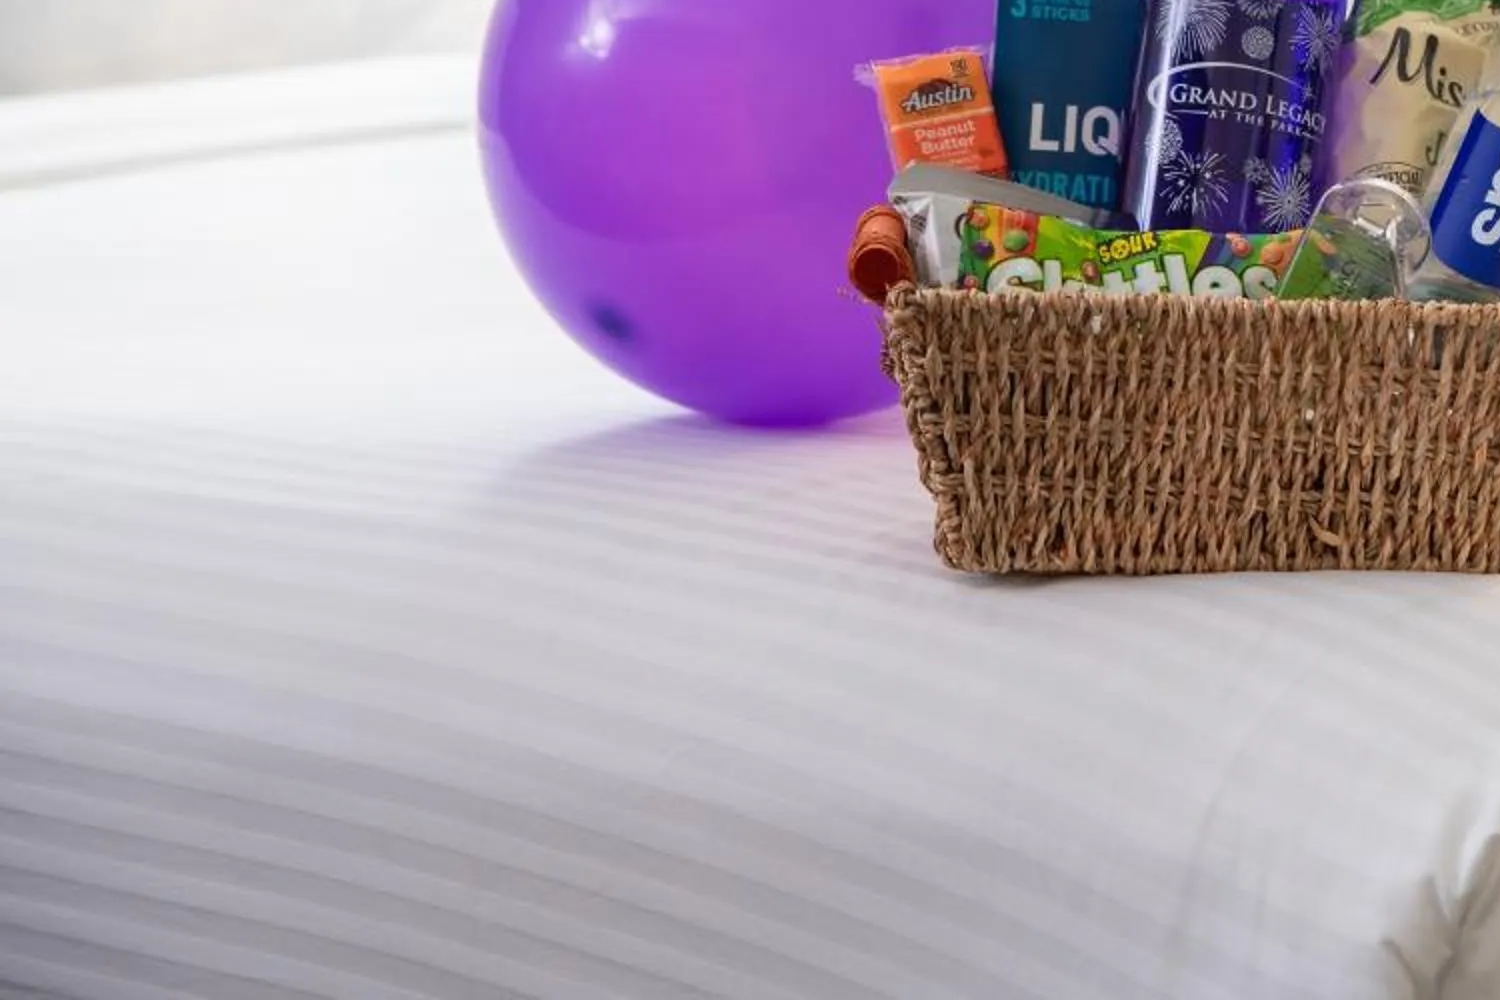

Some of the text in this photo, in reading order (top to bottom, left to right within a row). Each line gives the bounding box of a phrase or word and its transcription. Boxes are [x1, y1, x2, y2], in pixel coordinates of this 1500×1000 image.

[1031, 5, 1090, 21] STICKS
[901, 82, 973, 113] Austin
[1169, 83, 1327, 134] GRAND LEGACY
[914, 119, 976, 141] Peanut
[1208, 109, 1227, 120] AT
[1234, 111, 1265, 127] THE
[921, 134, 976, 155] Butter
[1013, 170, 1112, 204] YDRATI
[1099, 231, 1158, 263] SOUR
